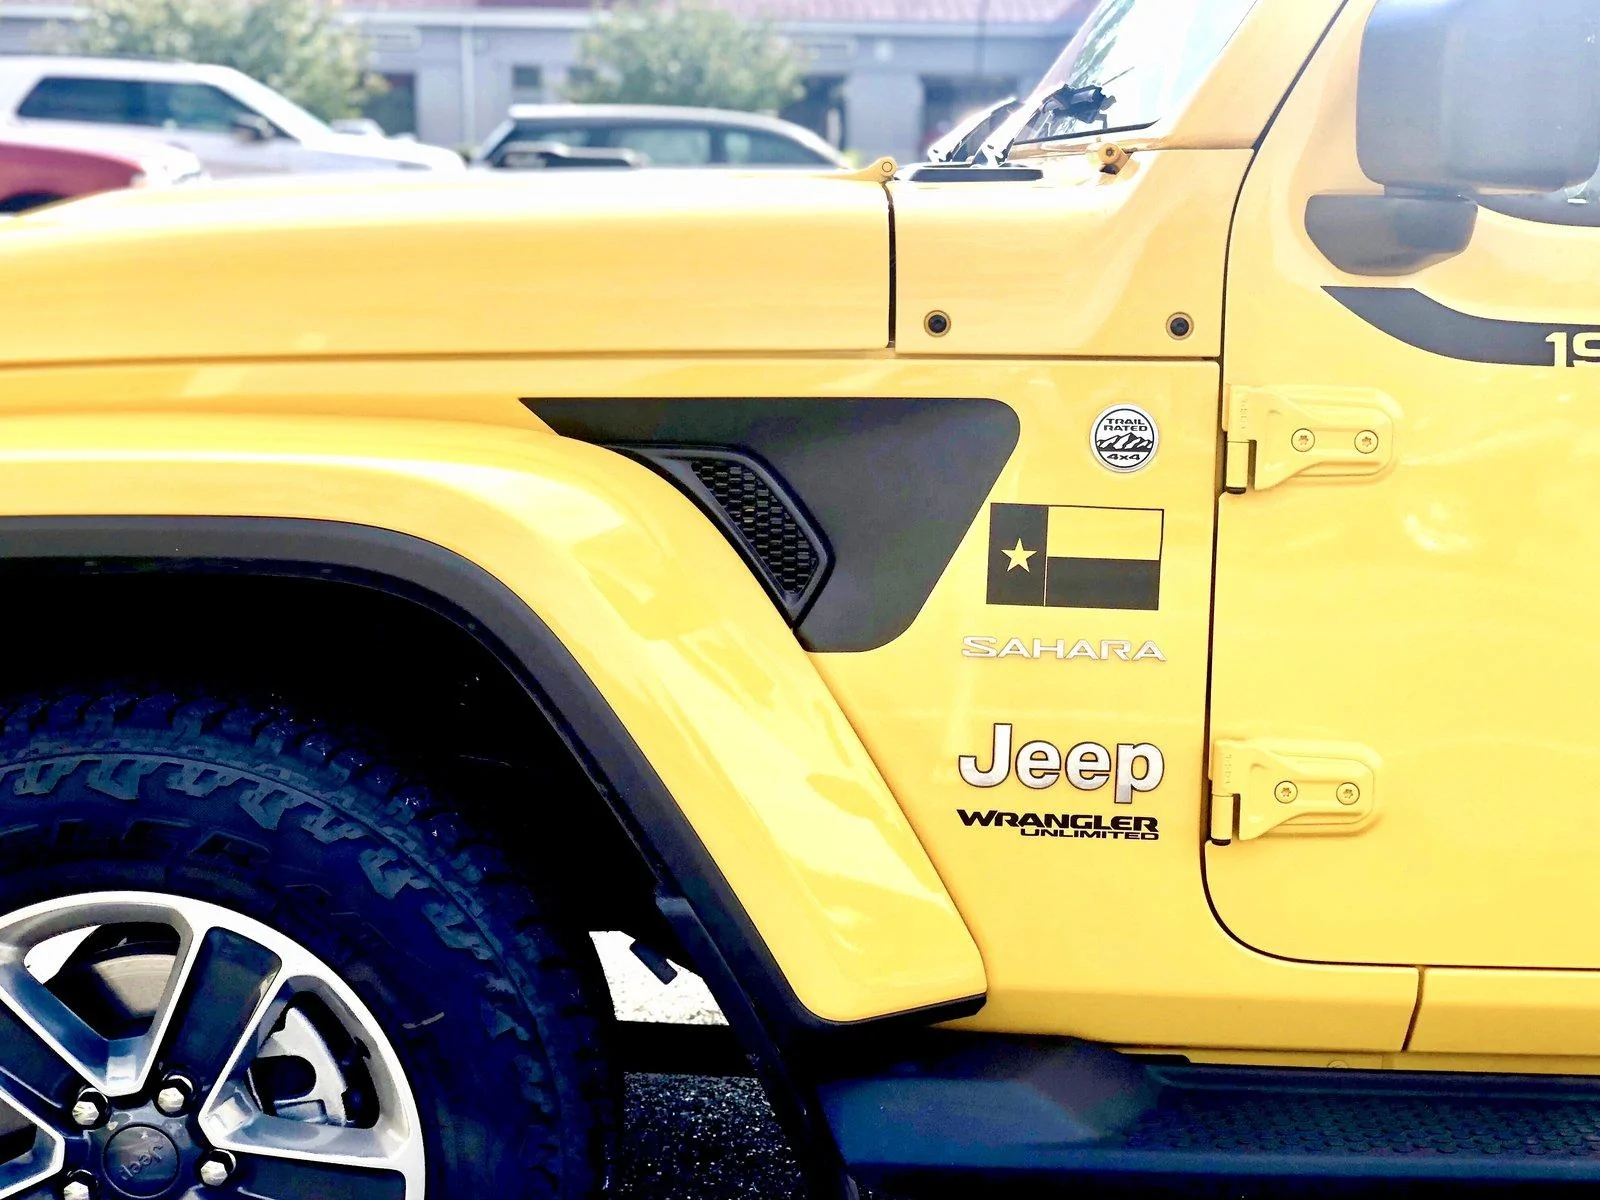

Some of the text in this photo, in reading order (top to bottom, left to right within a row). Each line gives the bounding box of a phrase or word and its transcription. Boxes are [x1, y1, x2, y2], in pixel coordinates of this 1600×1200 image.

[961, 635, 1167, 662] SAHARA
[958, 722, 1165, 805] Jeep
[956, 809, 1159, 832] WRANGLER
[1020, 828, 1159, 841] UNLIMITED
[119, 1145, 164, 1181] Jeep
